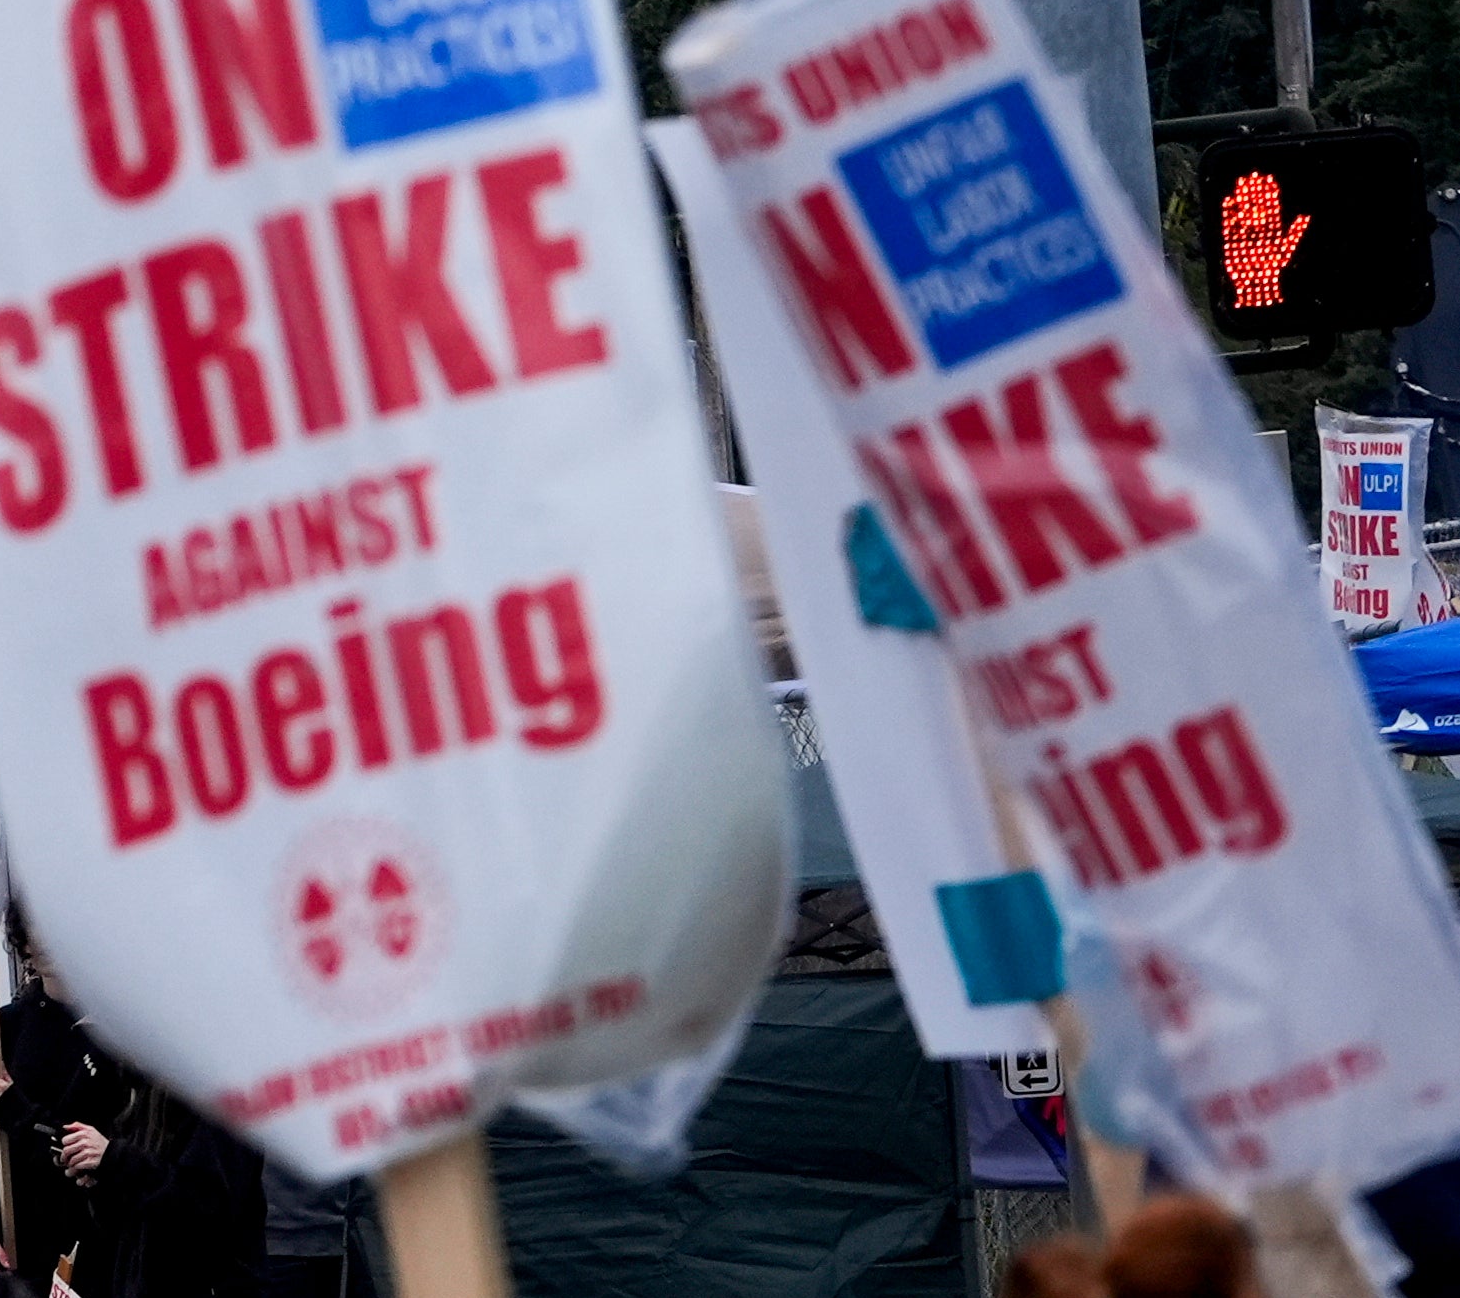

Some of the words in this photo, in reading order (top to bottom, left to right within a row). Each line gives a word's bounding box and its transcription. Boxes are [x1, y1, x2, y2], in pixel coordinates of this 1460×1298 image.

[1360, 441, 1403, 456] UNION
[1363, 474, 1399, 493] ULP!
[139, 461, 440, 633] AGAINST
[81, 574, 609, 856] Boeing
